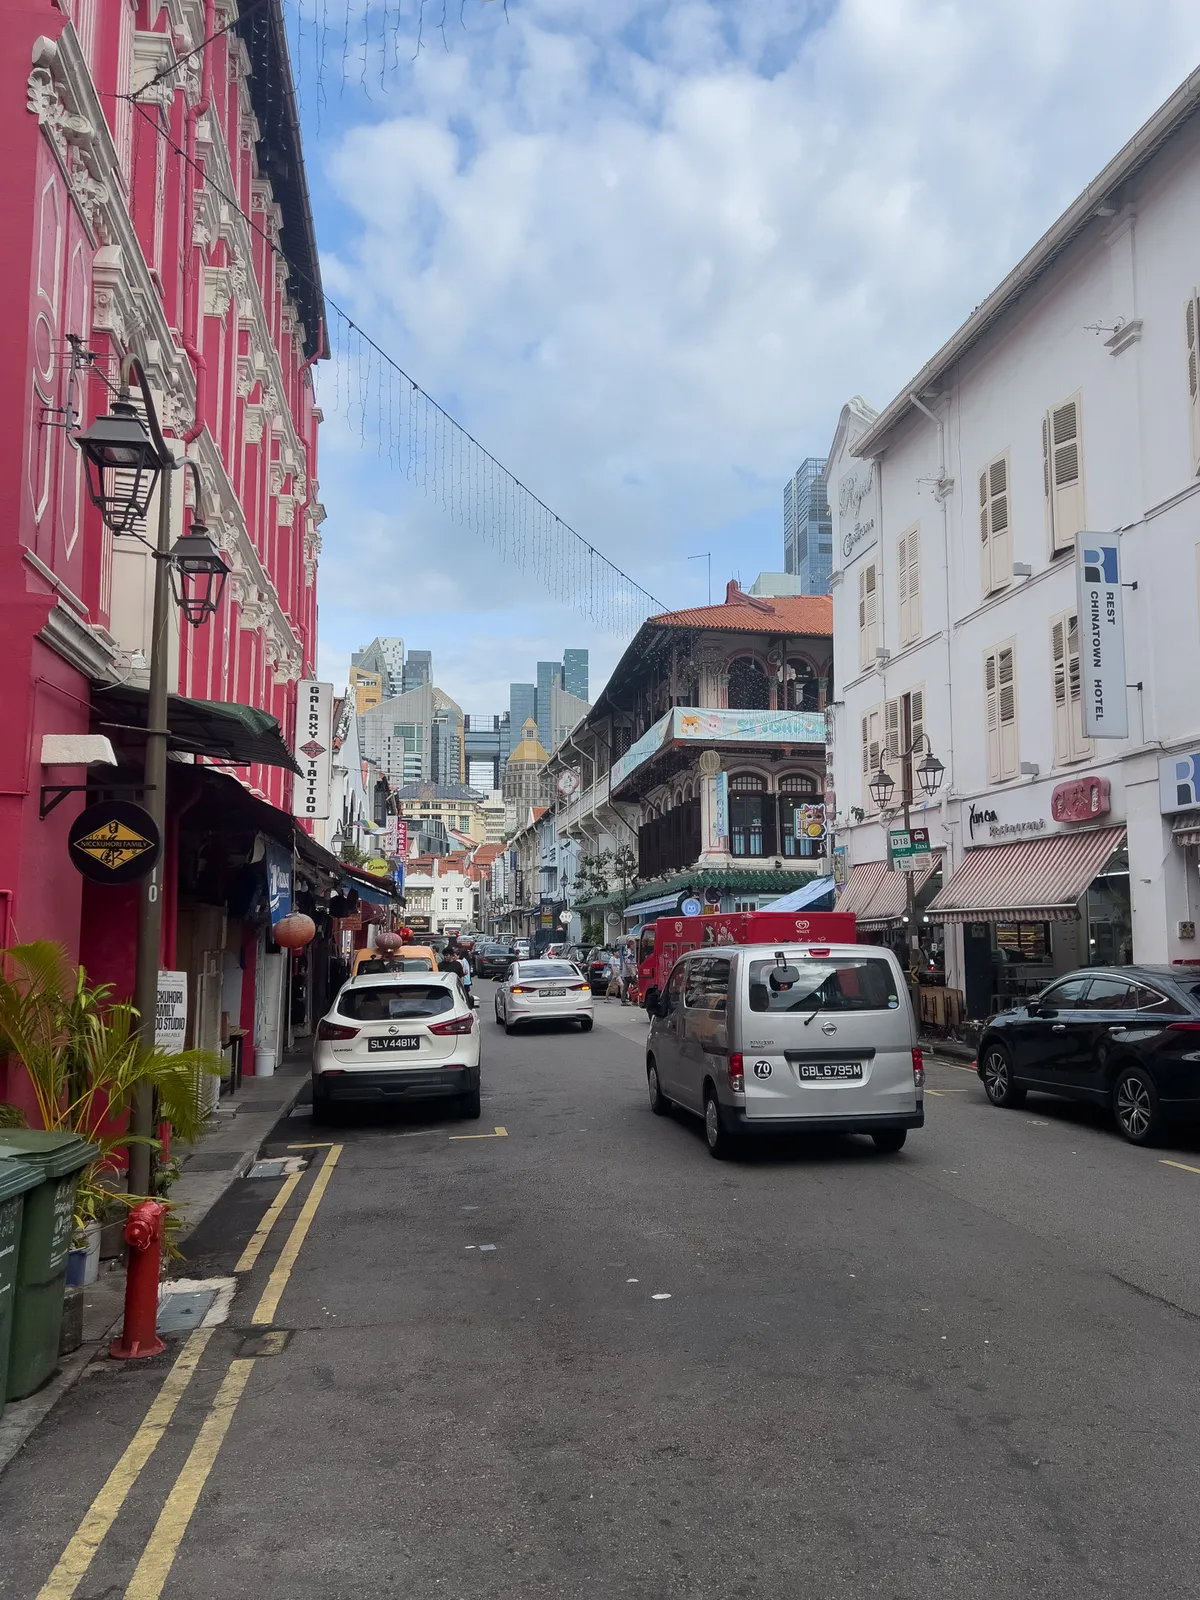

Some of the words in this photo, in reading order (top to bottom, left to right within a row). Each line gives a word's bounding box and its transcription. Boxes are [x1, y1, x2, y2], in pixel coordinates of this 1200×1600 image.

[1105, 592, 1116, 626] REST
[1090, 591, 1102, 668] CHINATOWN
[1094, 679, 1104, 722] HOTEL
[309, 686, 320, 739] GALAXY
[306, 760, 318, 813] TATTOO
[80, 840, 122, 848] NICCKUHORI
[123, 840, 148, 849] FAMILY
[892, 837, 909, 846] D18
[914, 842, 928, 850] Taxi
[895, 860, 902, 869] 1
[163, 1018, 186, 1030] STUDIO
[757, 1063, 770, 1073] 70
[802, 1064, 861, 1077] GBL6795M
